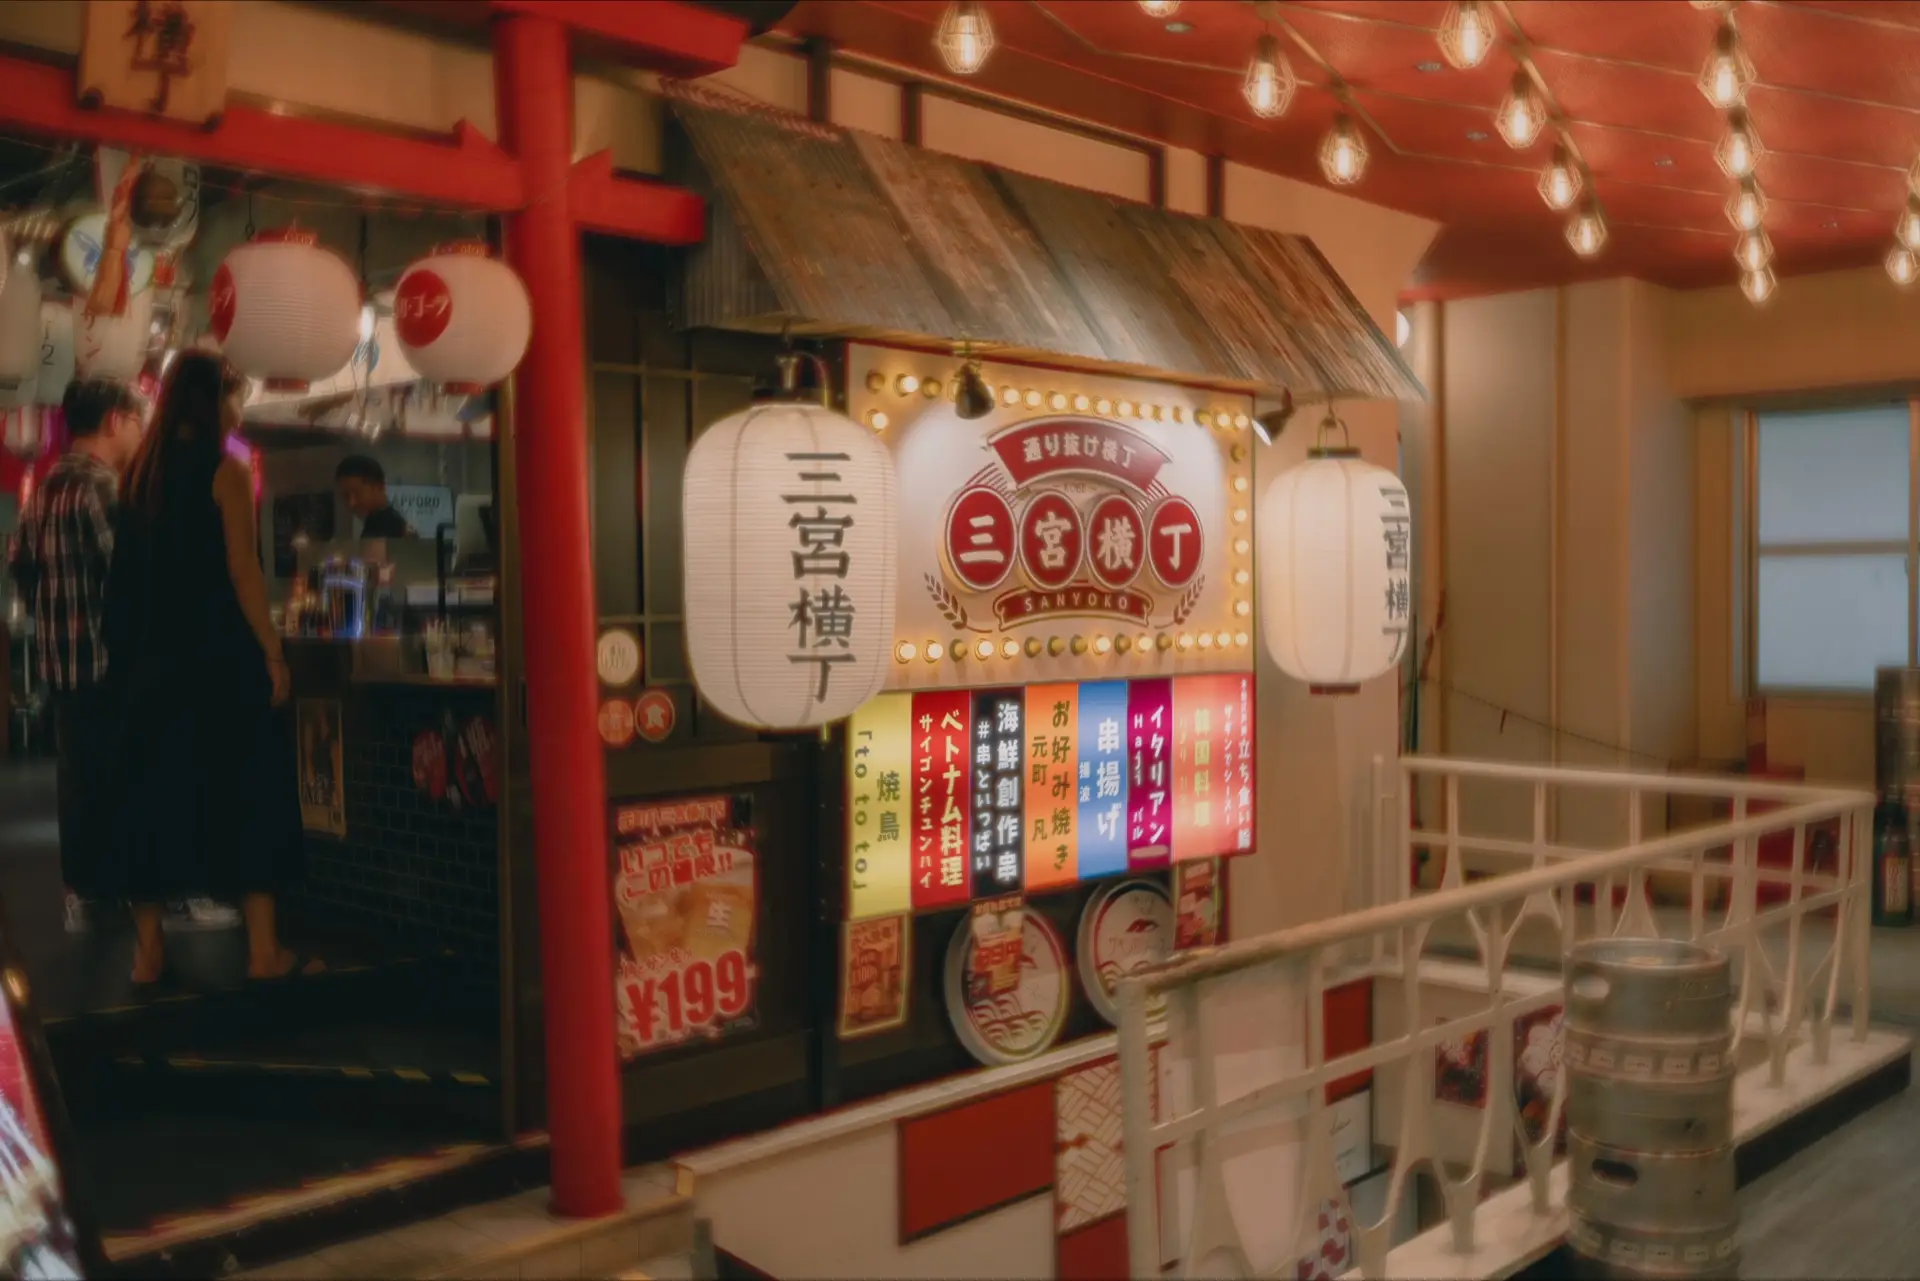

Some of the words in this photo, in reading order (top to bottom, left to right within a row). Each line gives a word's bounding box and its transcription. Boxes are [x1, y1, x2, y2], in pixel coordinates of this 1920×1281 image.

[1022, 431, 1138, 470] 通り抜け横丁
[779, 449, 859, 702] 三宮横丁
[959, 510, 1194, 572] 三宮横丁
[1024, 591, 1130, 613] SANYOKO
[876, 769, 901, 843] 焼鳥
[940, 708, 964, 887] ベトナム料理
[997, 702, 1020, 882] 海鮮創作串
[1051, 699, 1071, 872] お好み焼き
[1096, 716, 1122, 841] 串揚げ
[1149, 704, 1165, 845] イタリアン
[626, 949, 748, 1042] ¥199
